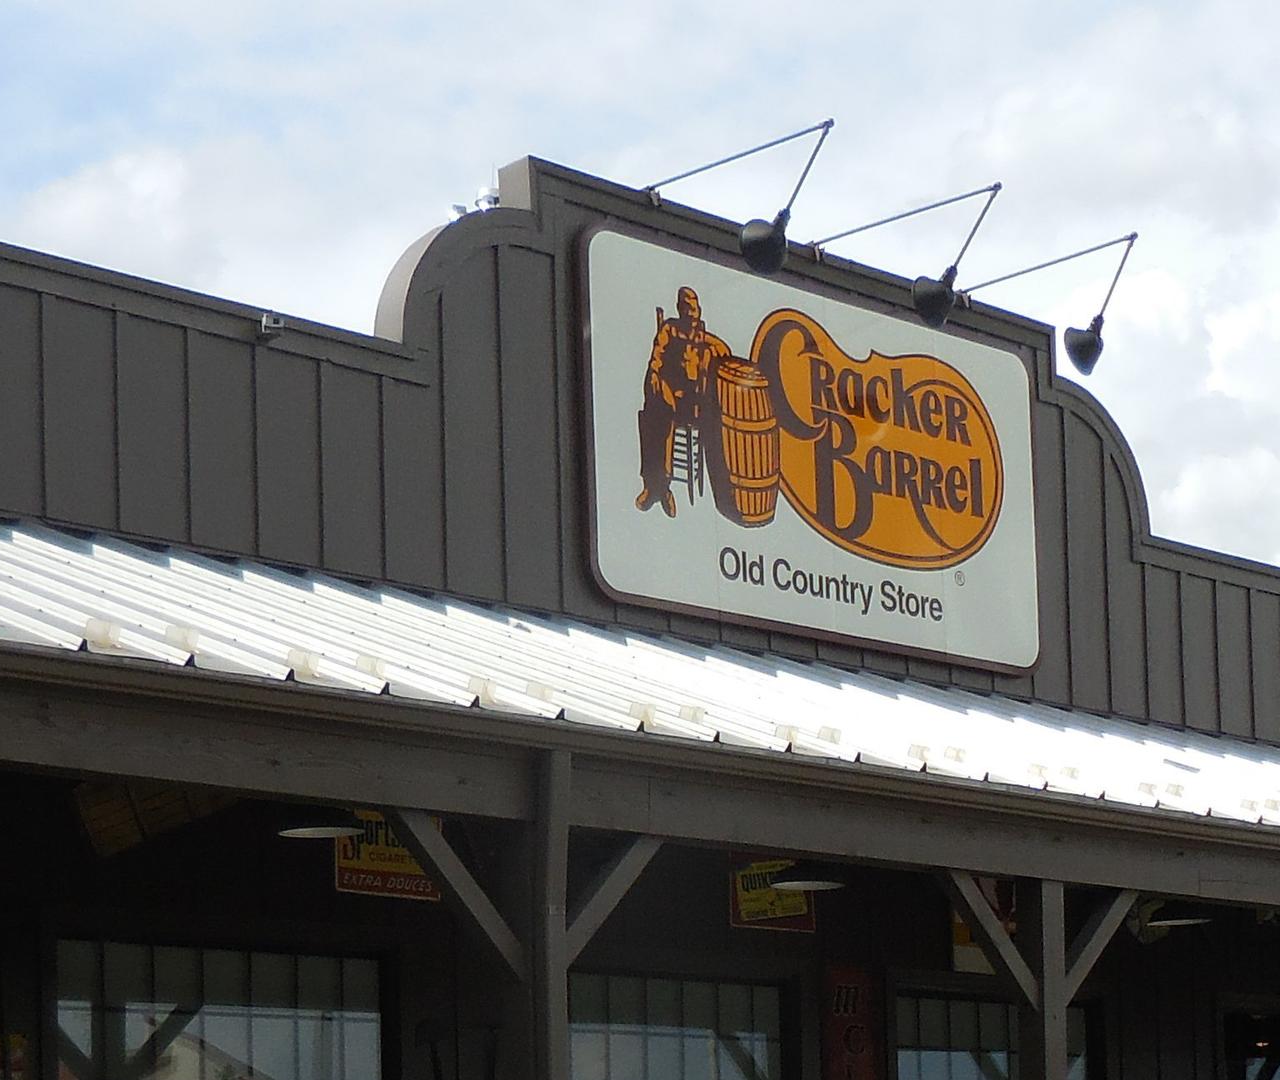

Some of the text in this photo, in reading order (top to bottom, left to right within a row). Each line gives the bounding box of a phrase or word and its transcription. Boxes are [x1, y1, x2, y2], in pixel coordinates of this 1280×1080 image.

[758, 319, 971, 447] Cracker
[813, 408, 984, 545] Barrel
[720, 546, 944, 622] Old Country Store
[342, 872, 433, 893] EXTRA DOUCES
